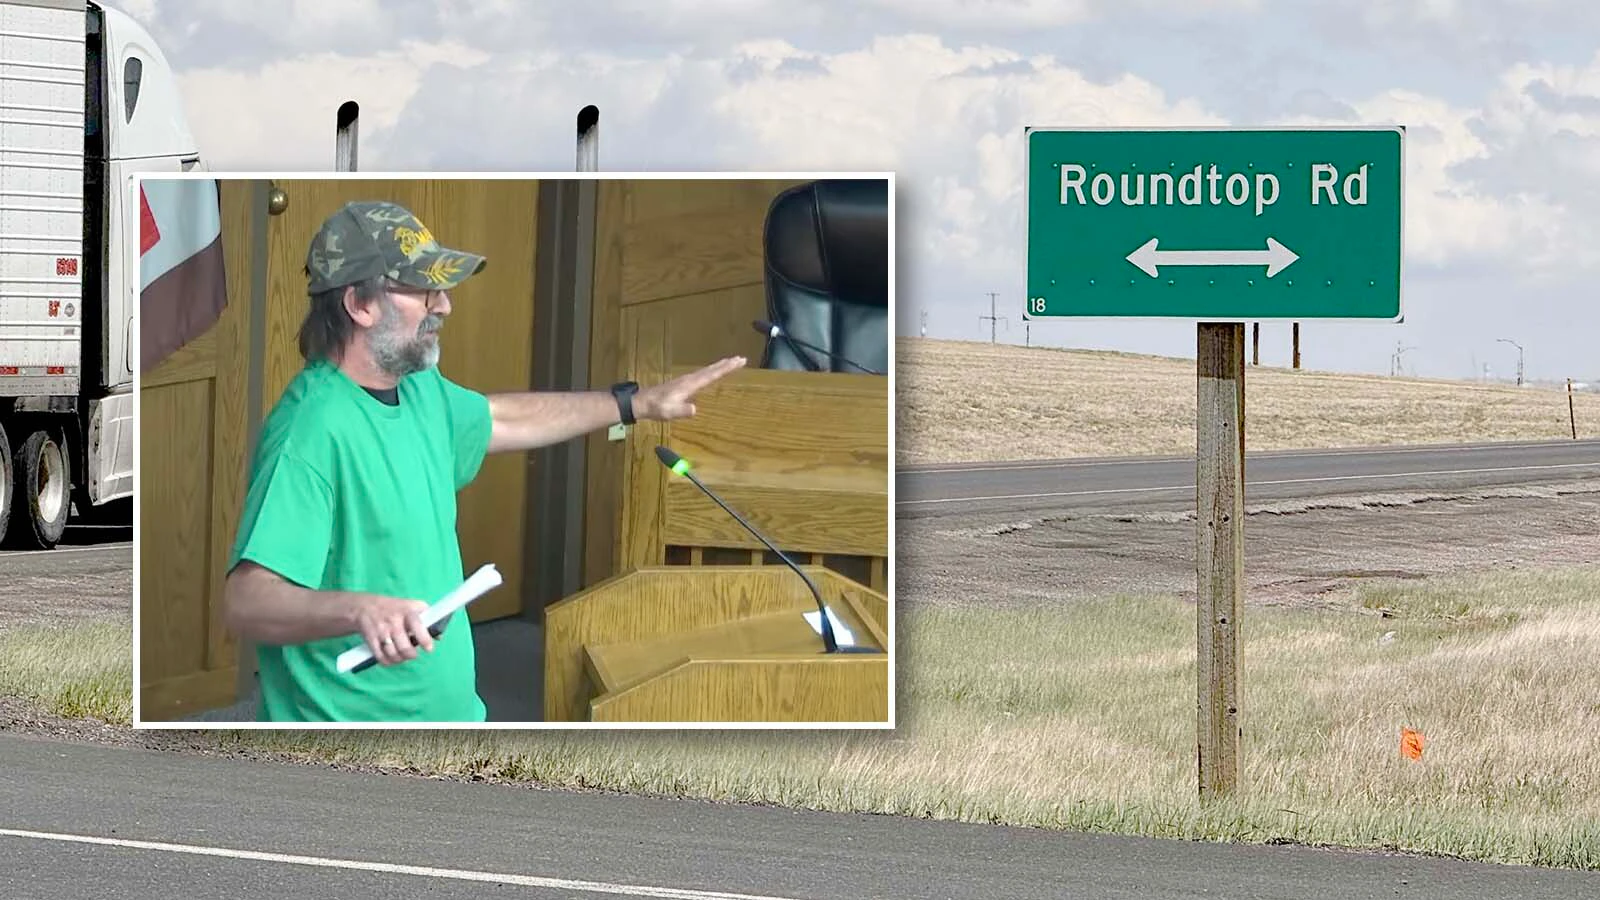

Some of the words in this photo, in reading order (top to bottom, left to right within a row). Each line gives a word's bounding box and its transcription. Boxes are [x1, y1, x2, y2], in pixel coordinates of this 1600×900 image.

[1060, 164, 1280, 216] Roundtop
[1311, 164, 1368, 205] Rd
[1031, 298, 1046, 312] 18
